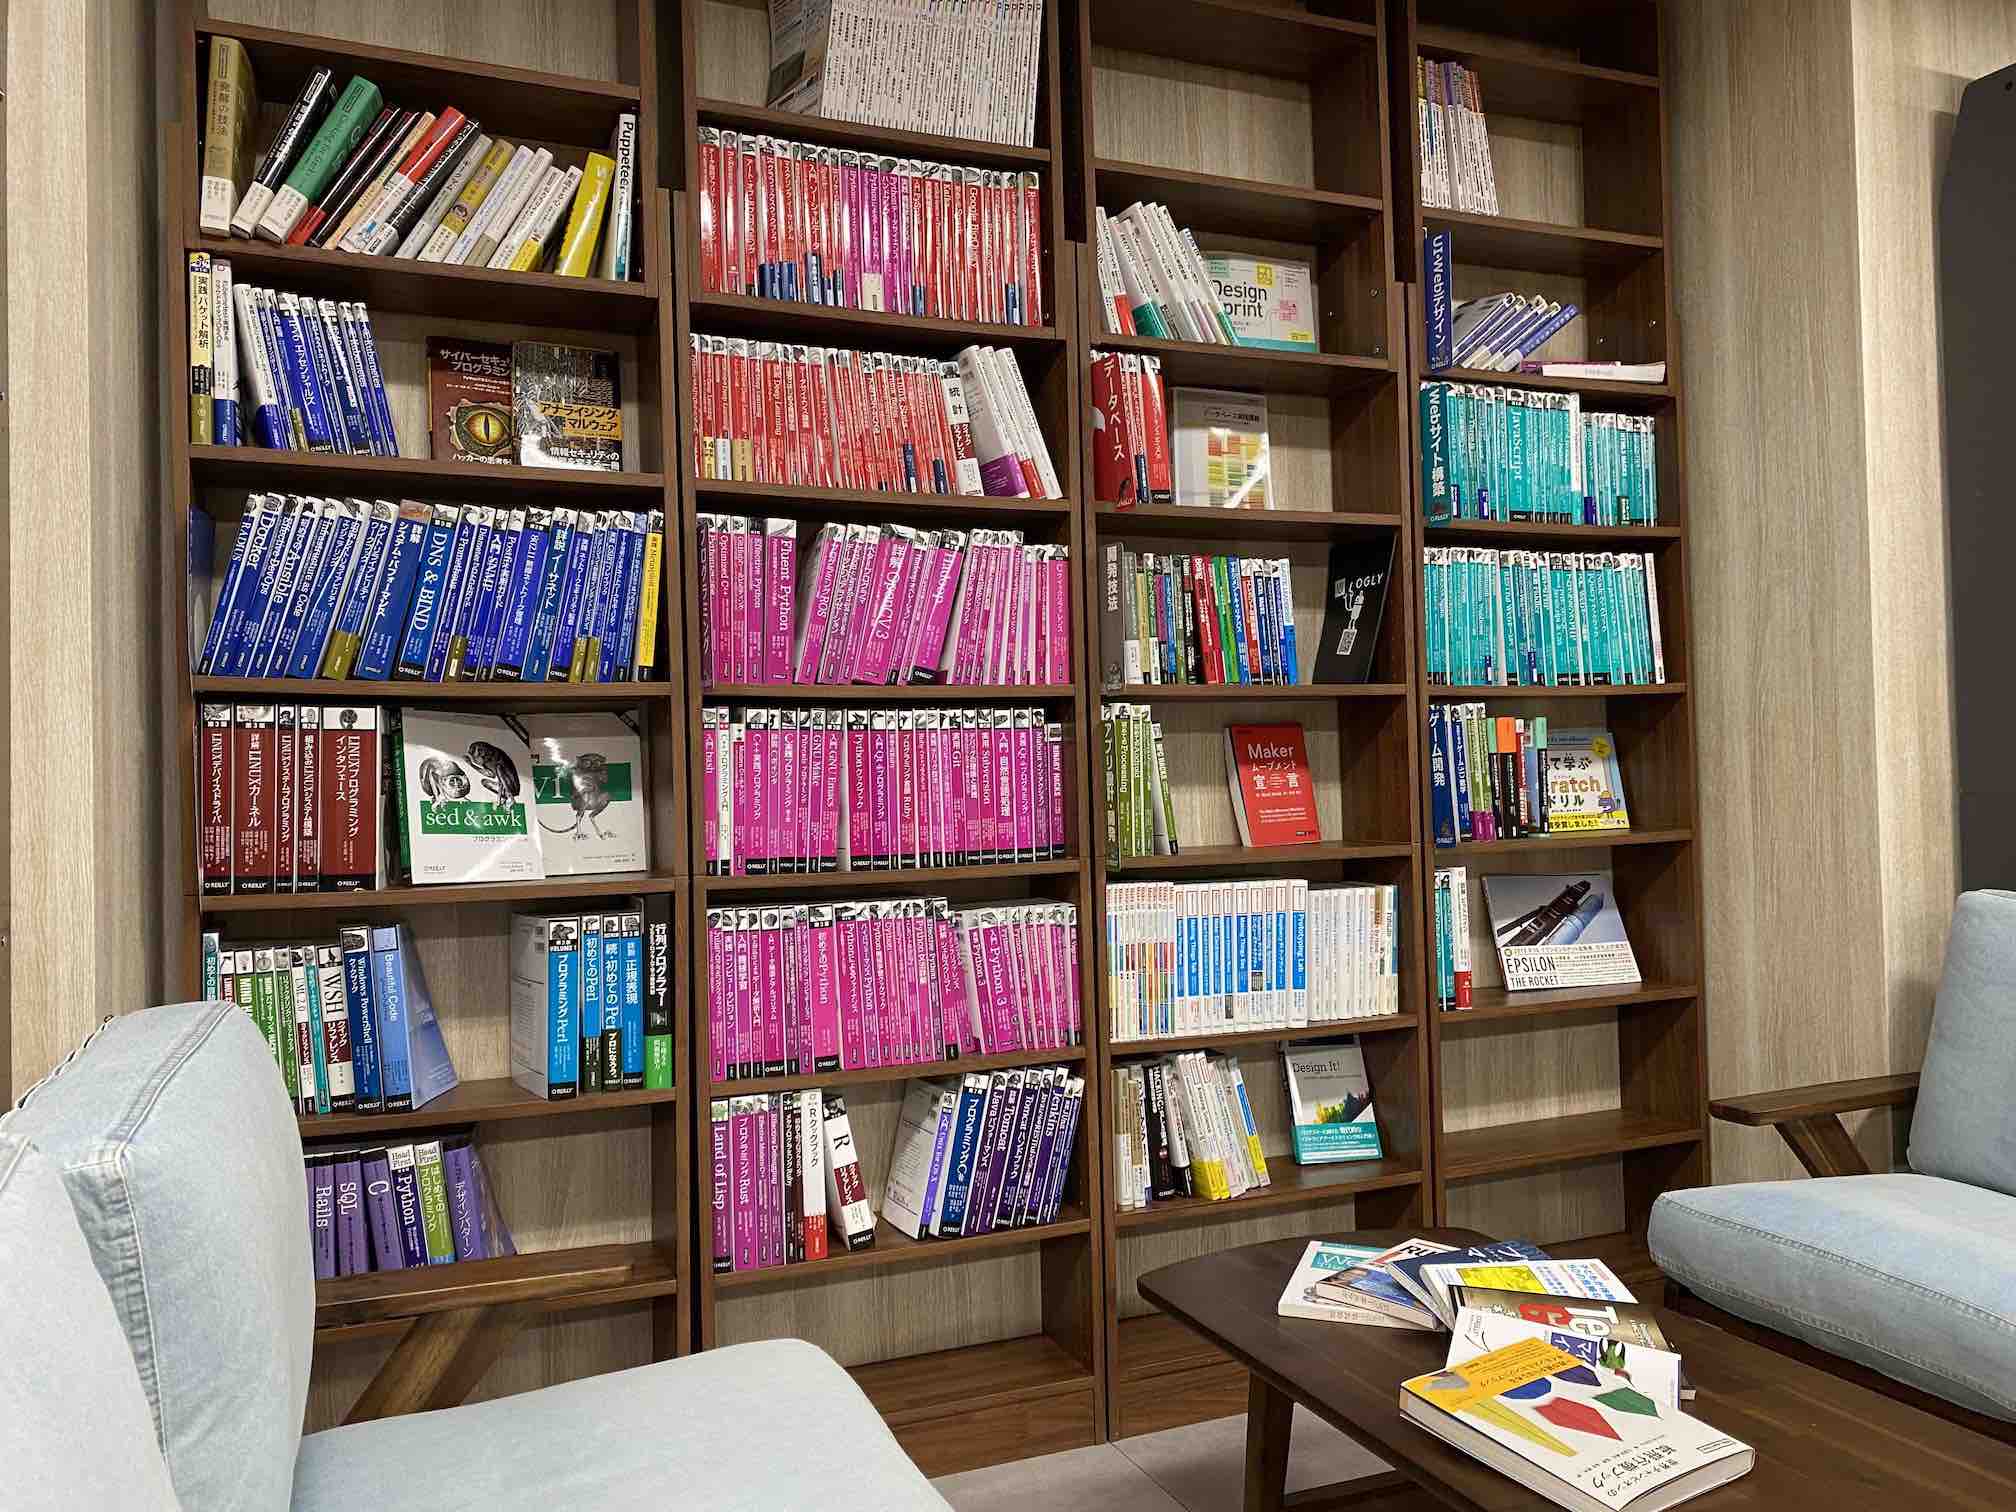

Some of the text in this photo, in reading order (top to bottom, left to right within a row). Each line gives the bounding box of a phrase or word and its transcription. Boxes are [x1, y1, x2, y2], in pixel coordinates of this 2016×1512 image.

[1212, 280, 1268, 303] Design
[1222, 300, 1265, 319] print
[451, 361, 512, 375] プログラミン
[540, 401, 618, 419] アナライジング
[949, 386, 964, 415] 統計
[1103, 359, 1125, 461] データベース
[566, 418, 618, 431] マルウェア
[1428, 384, 1447, 497] Webサイト構築
[1510, 410, 1523, 481] JavaScript
[232, 519, 252, 562] RADIUS
[246, 513, 275, 571] Docker
[427, 531, 449, 567] DNS
[719, 535, 729, 580] Optimized
[260, 559, 279, 596] DevOps
[481, 555, 500, 593] SNMP
[778, 538, 793, 631] Fluent Python
[292, 593, 308, 618] Code
[412, 588, 430, 631] BIND
[753, 577, 763, 609] Python
[877, 570, 901, 631] OpenCV
[705, 751, 715, 775] bash
[812, 734, 822, 785] GNU Make
[827, 751, 838, 772] GNU
[952, 752, 962, 768] Git
[1247, 741, 1297, 760] Maker
[1428, 712, 1446, 786] ゲーム開発
[335, 735, 347, 801] インタフェース
[982, 749, 991, 806] Subversion
[1551, 776, 1601, 793] ratch
[425, 808, 522, 827] sed & awk
[902, 796, 913, 820] Ruby
[585, 937, 598, 1002] 初めてのPerl
[654, 922, 668, 1007] 行列プログラマー
[972, 943, 984, 978] Python
[989, 947, 1004, 995] Python
[1506, 955, 1556, 974] EPSILON
[323, 972, 344, 1015] WSH
[384, 953, 398, 1021] Beautiful Code
[625, 959, 638, 1004] 正規表現
[1509, 975, 1560, 988] THE ROCKET
[357, 957, 371, 1045] Windows PowerShell
[996, 997, 1008, 1007] 3
[1292, 1060, 1327, 1074] Design
[997, 1105, 1016, 1152] Tomcat
[1020, 1094, 1035, 1131] Tomcat
[1045, 1090, 1063, 1137] Jenkins
[391, 1148, 411, 1159] Head
[833, 1132, 851, 1150] R
[393, 1158, 412, 1168] First
[712, 1126, 727, 1211] Land of Lisp
[770, 1144, 778, 1185] Debugging
[315, 1184, 333, 1229] Rails
[339, 1182, 358, 1216] SQL
[368, 1180, 389, 1196] C
[398, 1173, 416, 1226] Python
